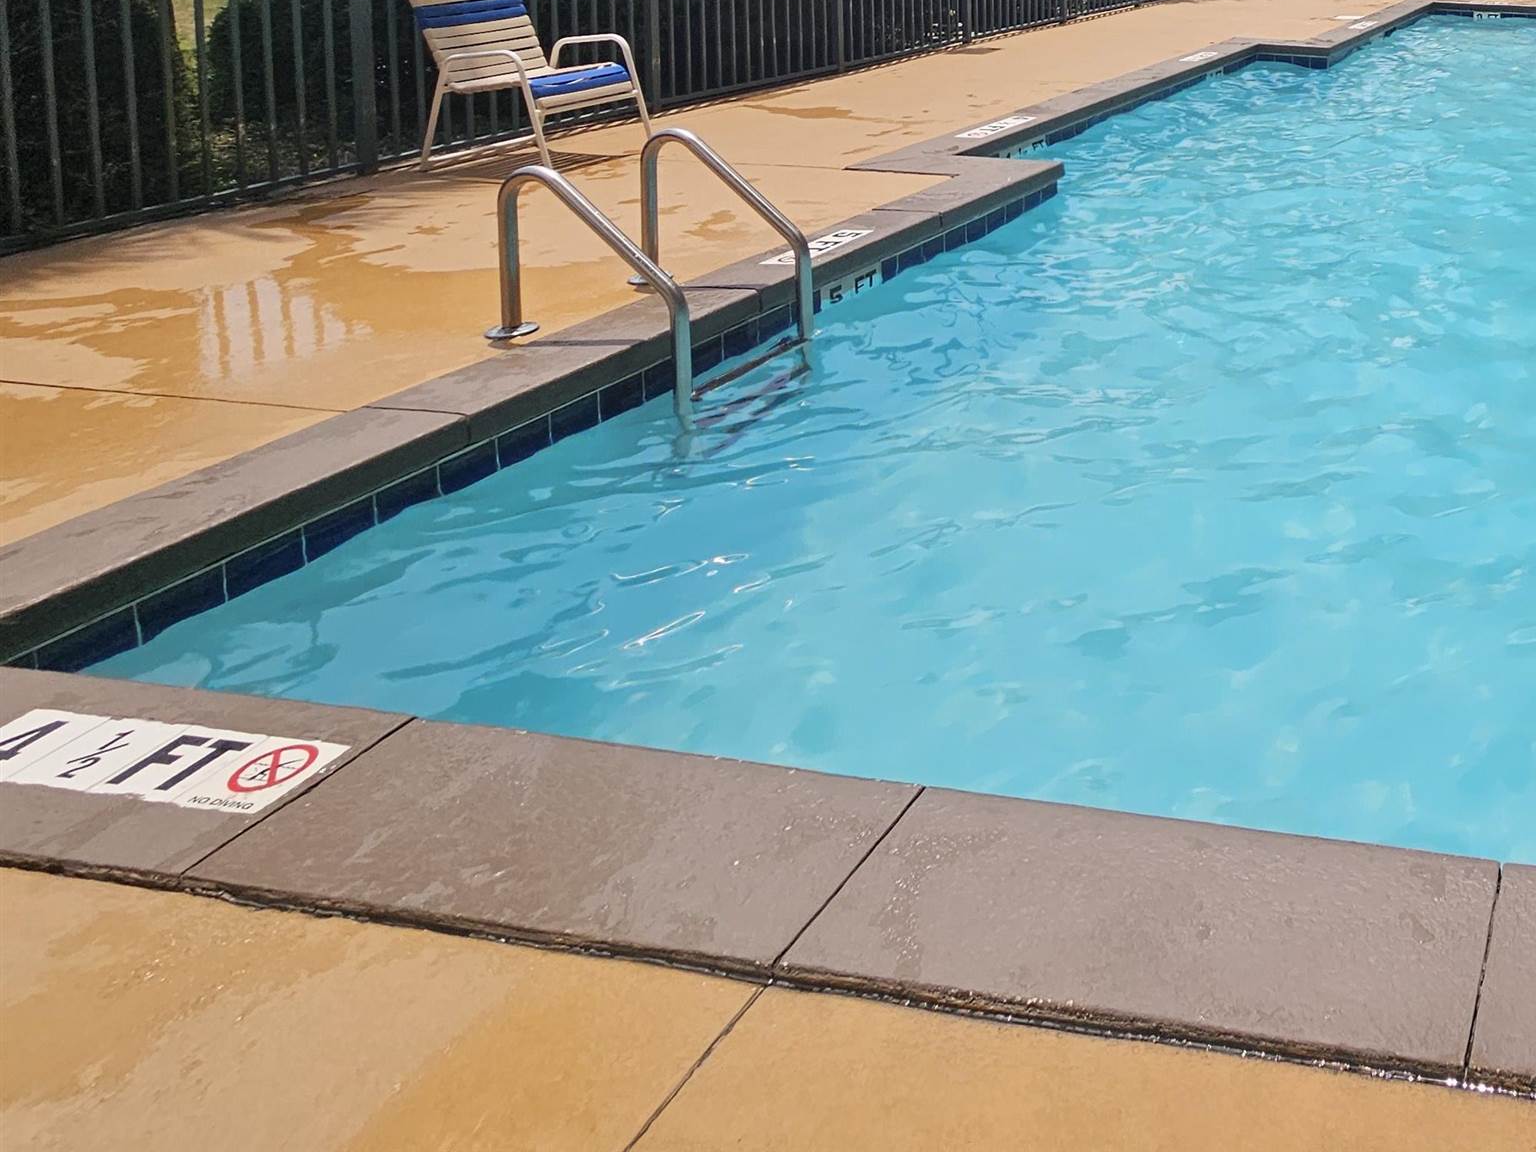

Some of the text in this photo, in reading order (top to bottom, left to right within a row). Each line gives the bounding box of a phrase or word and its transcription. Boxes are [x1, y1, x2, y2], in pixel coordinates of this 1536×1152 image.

[833, 231, 861, 239] 5
[830, 268, 877, 304] 5 FT
[0, 720, 69, 760] 4
[105, 734, 254, 791] FT
[187, 795, 254, 810] NO DIVING
